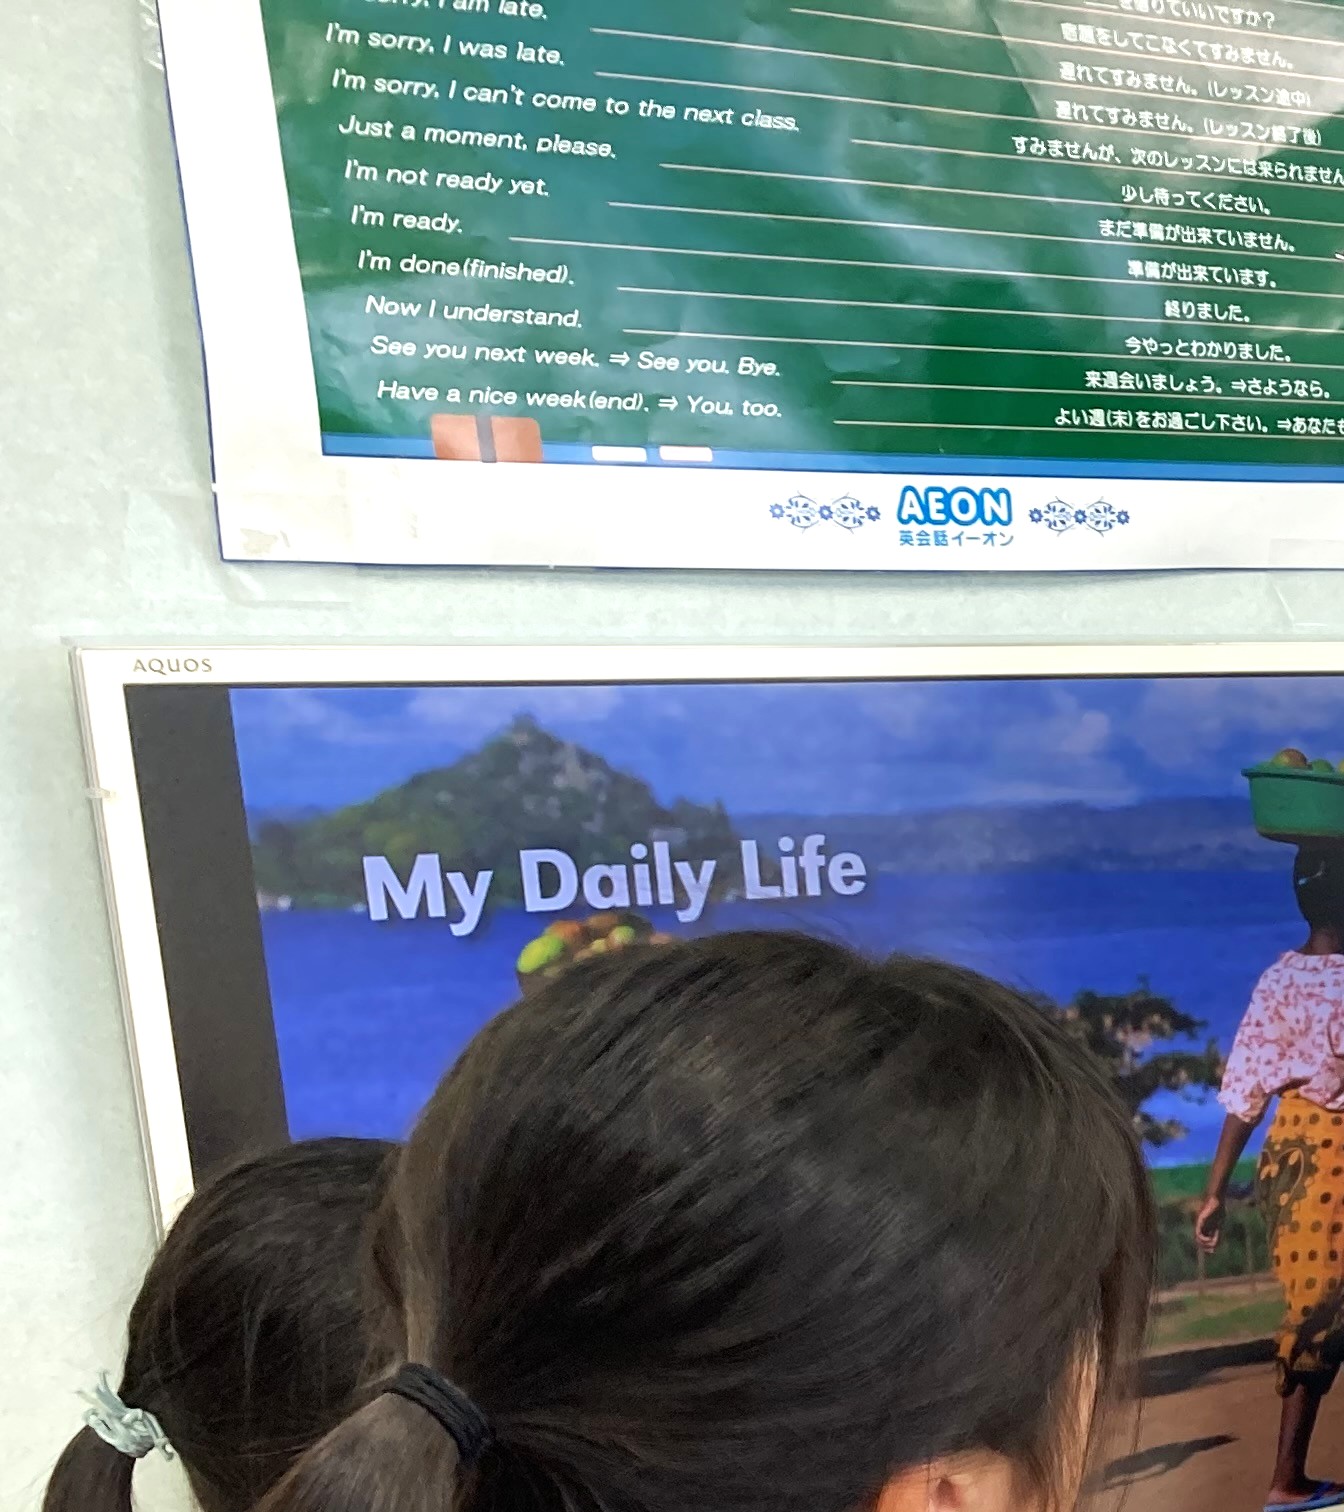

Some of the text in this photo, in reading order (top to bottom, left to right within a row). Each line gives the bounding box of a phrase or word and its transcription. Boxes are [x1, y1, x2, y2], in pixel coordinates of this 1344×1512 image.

[498, 0, 547, 20] late.
[326, 22, 359, 45] I'm
[443, 34, 452, 54] I
[459, 41, 508, 59] was
[516, 42, 565, 66] late.
[332, 68, 366, 91] I'm
[448, 79, 457, 99] I
[463, 84, 525, 106] can't
[532, 93, 597, 112] come
[605, 97, 630, 115] to
[638, 99, 676, 119] the
[684, 106, 735, 125] next
[741, 109, 800, 132] class.
[338, 115, 617, 159] Just a moment, please.
[345, 159, 550, 197] I'm not ready yet.
[1121, 184, 1271, 216] 少し待ってください。
[351, 204, 463, 234] I'm ready.
[1098, 218, 1295, 252] まだ準備が出来ていません。
[358, 249, 391, 271] I'm
[1127, 260, 1277, 288] 準備が出来ています。
[364, 295, 583, 329] Now I understand.
[1164, 300, 1250, 322] 終りました。
[370, 335, 417, 357] See
[424, 343, 467, 360] you
[474, 346, 527, 363] next
[534, 348, 600, 368] week.
[637, 350, 680, 371] See
[737, 356, 781, 377] Bye.
[1124, 337, 1291, 363] 今やっとわかりました。
[377, 379, 439, 401] Have
[446, 388, 461, 403] a
[468, 386, 517, 405] nice
[742, 400, 782, 418] too.
[897, 485, 1013, 526] AEON
[898, 529, 1014, 547] 英会話イーオン
[133, 658, 213, 676] AQUOS
[361, 833, 868, 938] My Daily Life
